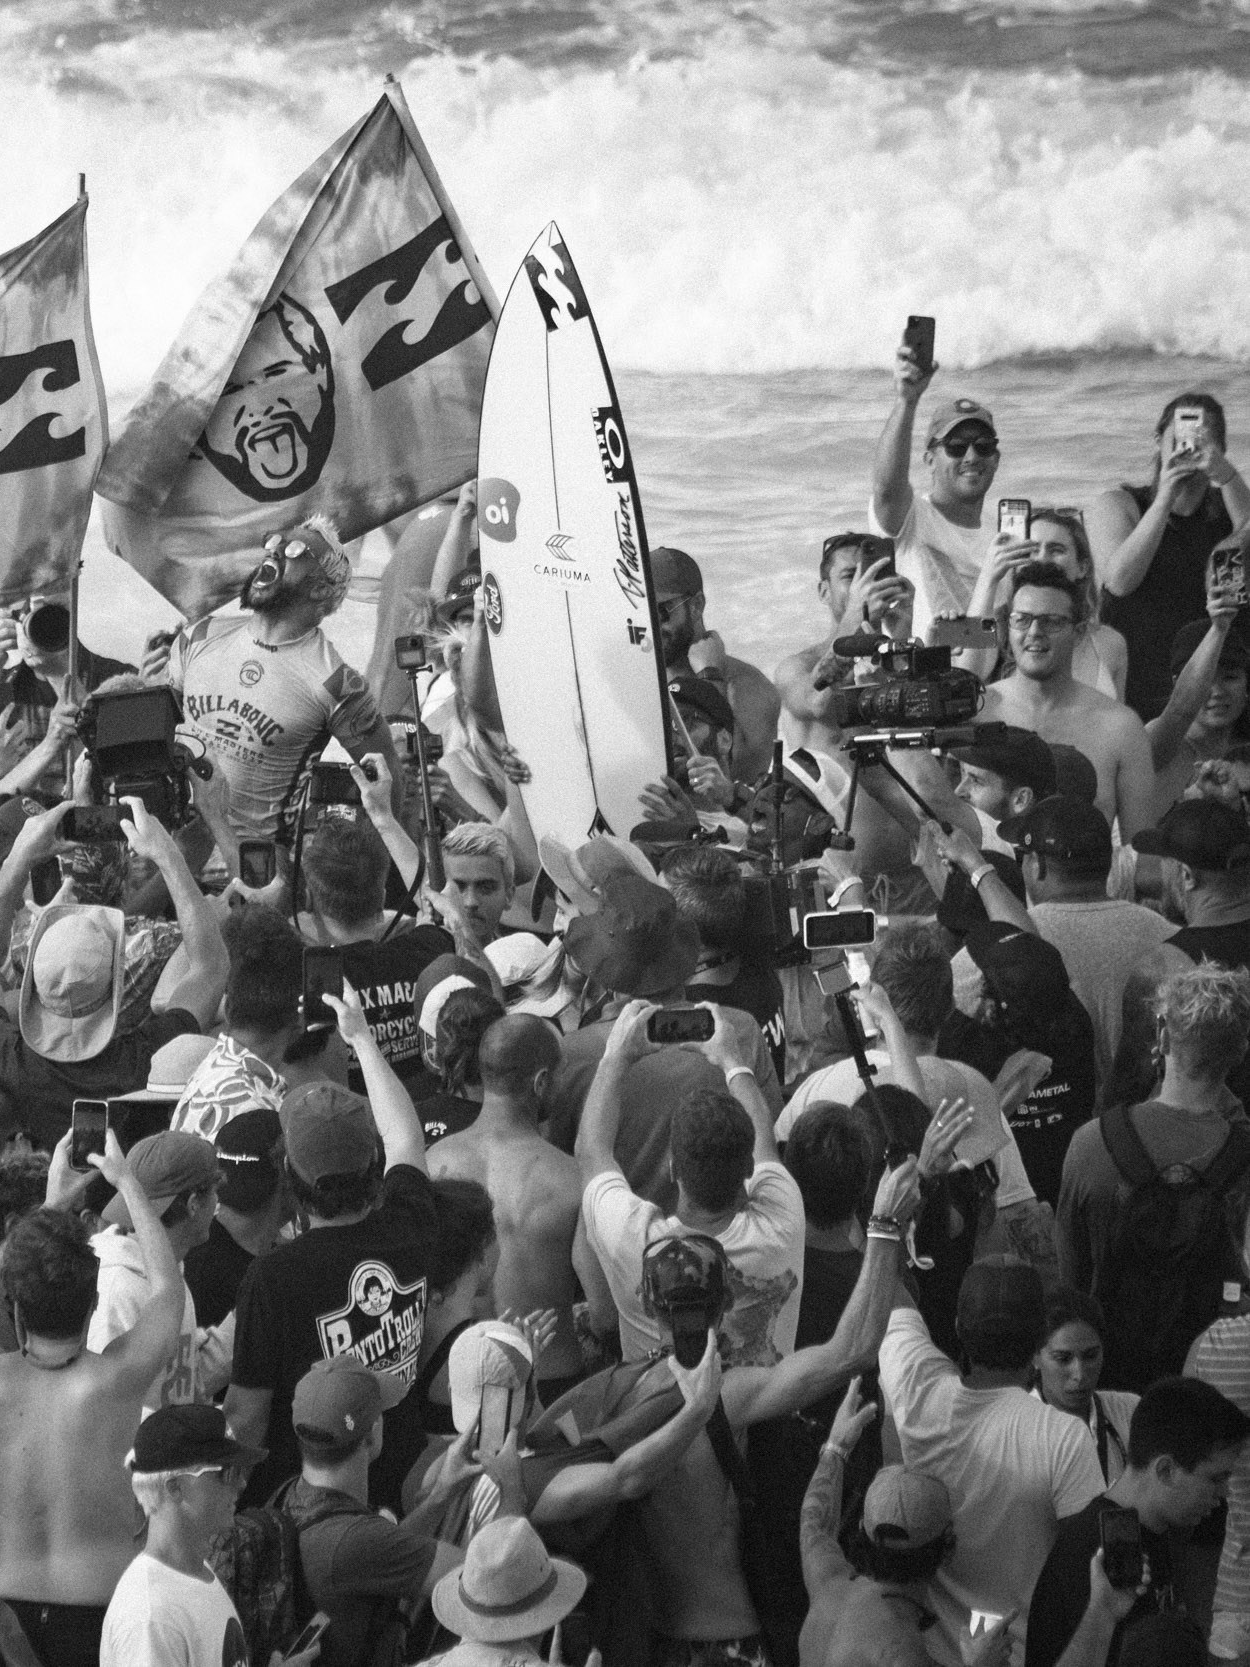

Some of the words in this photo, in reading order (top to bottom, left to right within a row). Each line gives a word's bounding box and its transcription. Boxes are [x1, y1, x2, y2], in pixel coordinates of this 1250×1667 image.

[485, 497, 511, 525] oi
[533, 564, 592, 583] CARIUMA
[485, 583, 502, 625] Ford
[252, 638, 278, 654] Jeep
[360, 987, 376, 1010] X
